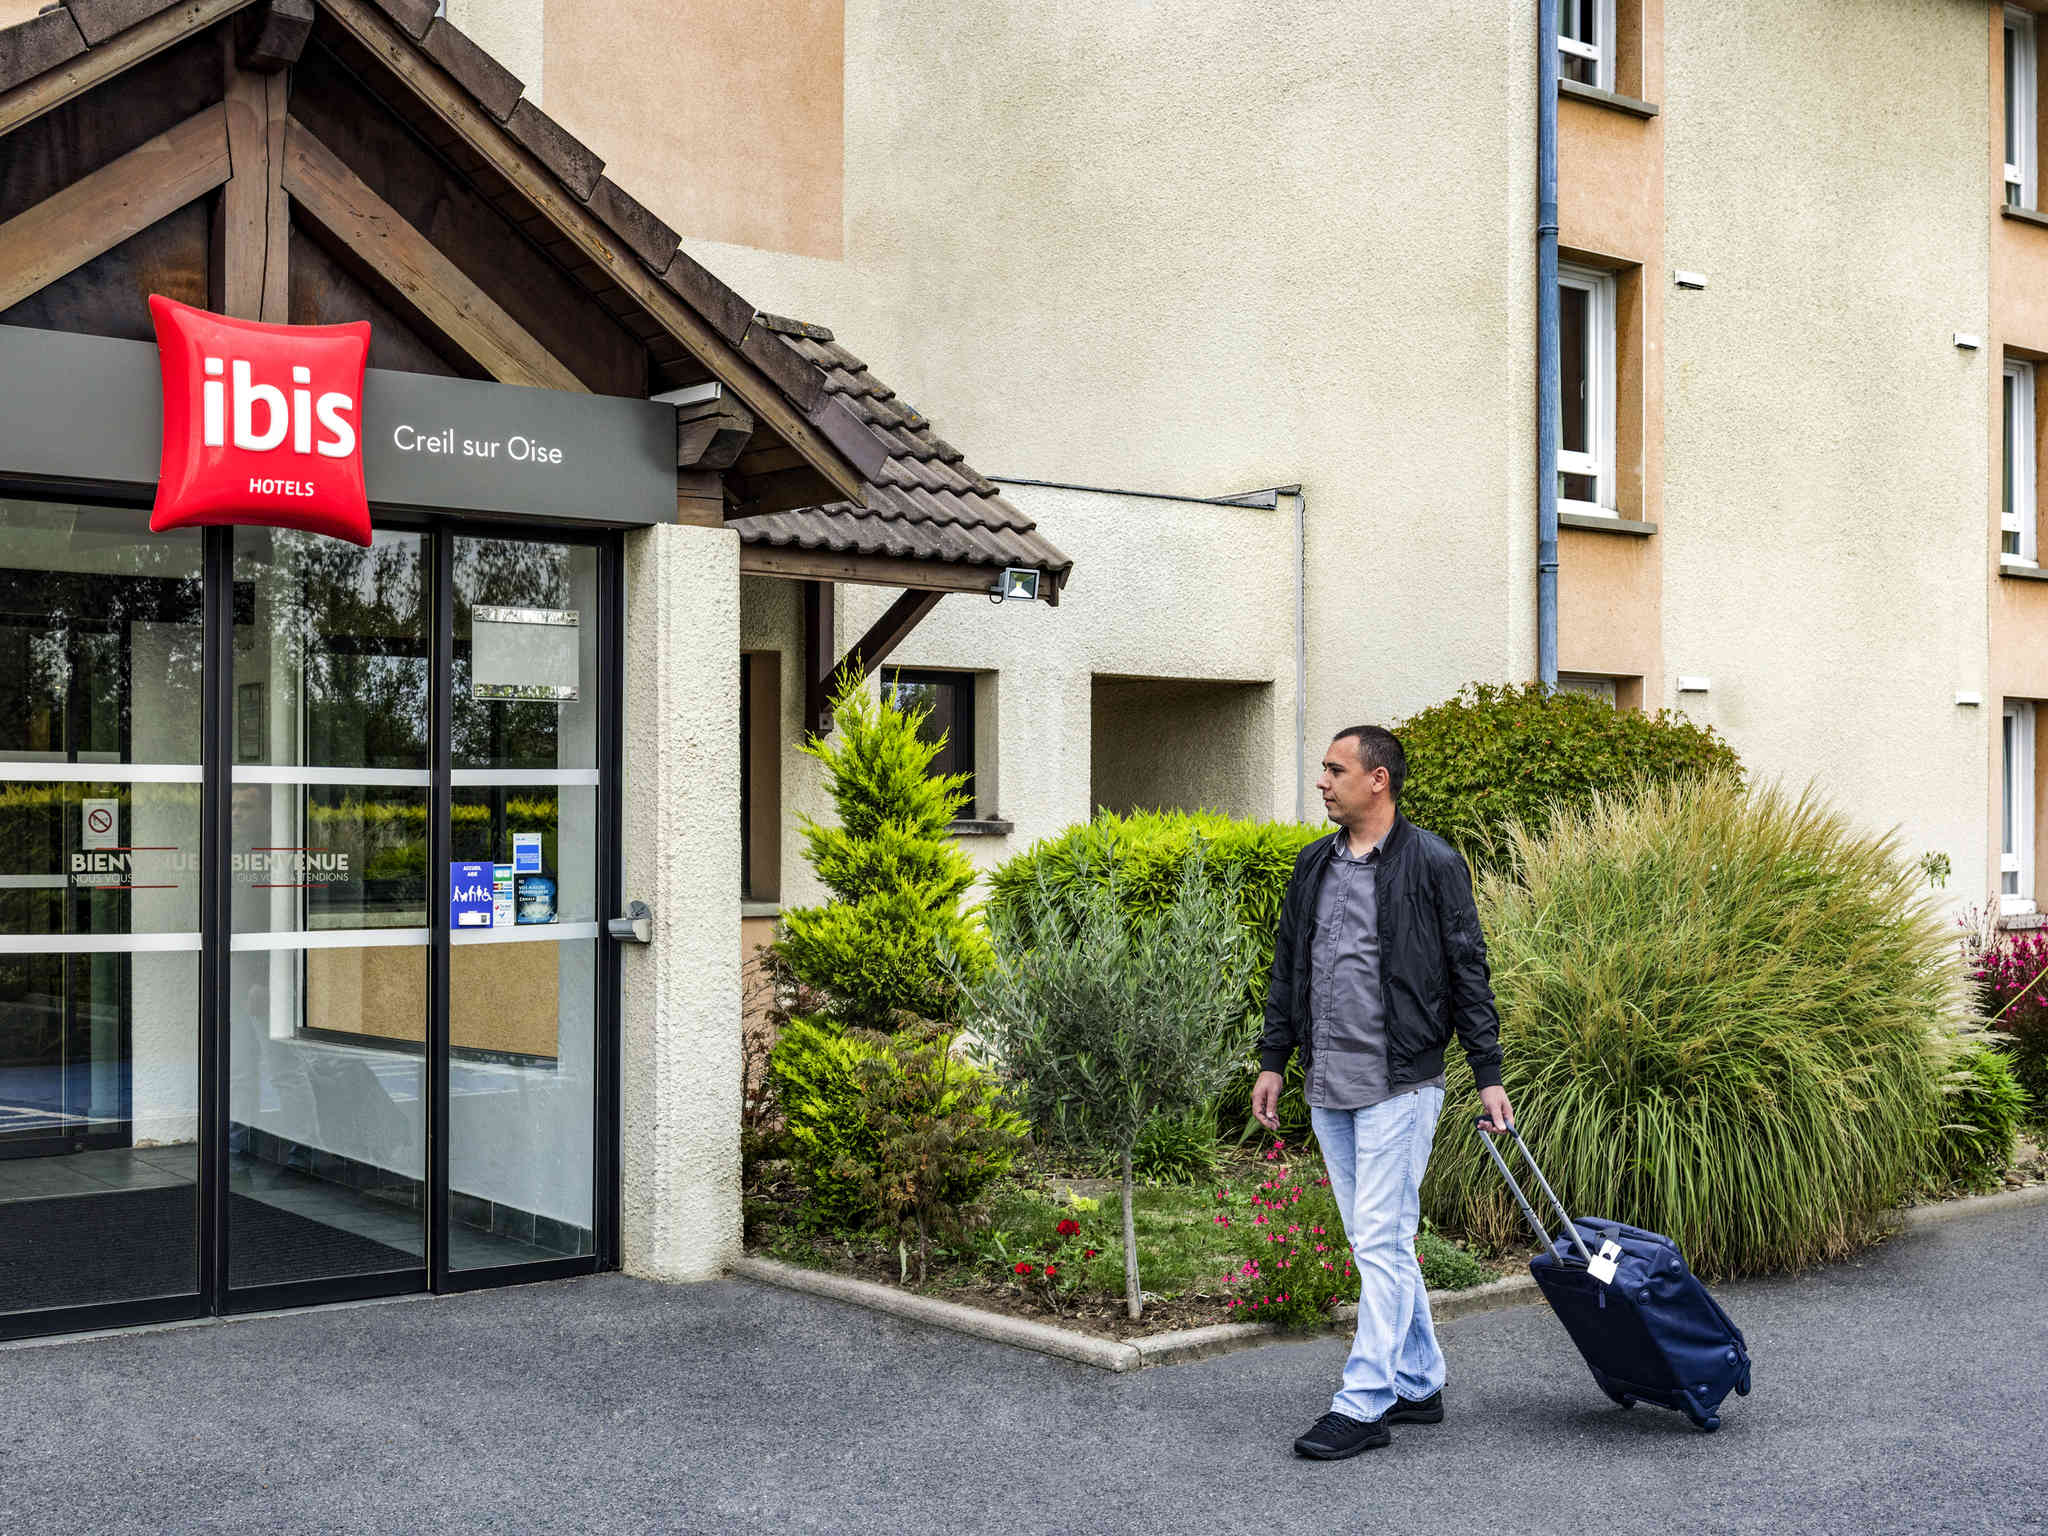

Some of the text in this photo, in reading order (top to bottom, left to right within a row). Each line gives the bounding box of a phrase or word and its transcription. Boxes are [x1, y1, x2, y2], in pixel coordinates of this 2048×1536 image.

[203, 357, 356, 458] ibis
[394, 424, 563, 464] Creil sur Oise
[249, 477, 314, 497] HOTELS
[231, 853, 349, 871] BIENVENUE
